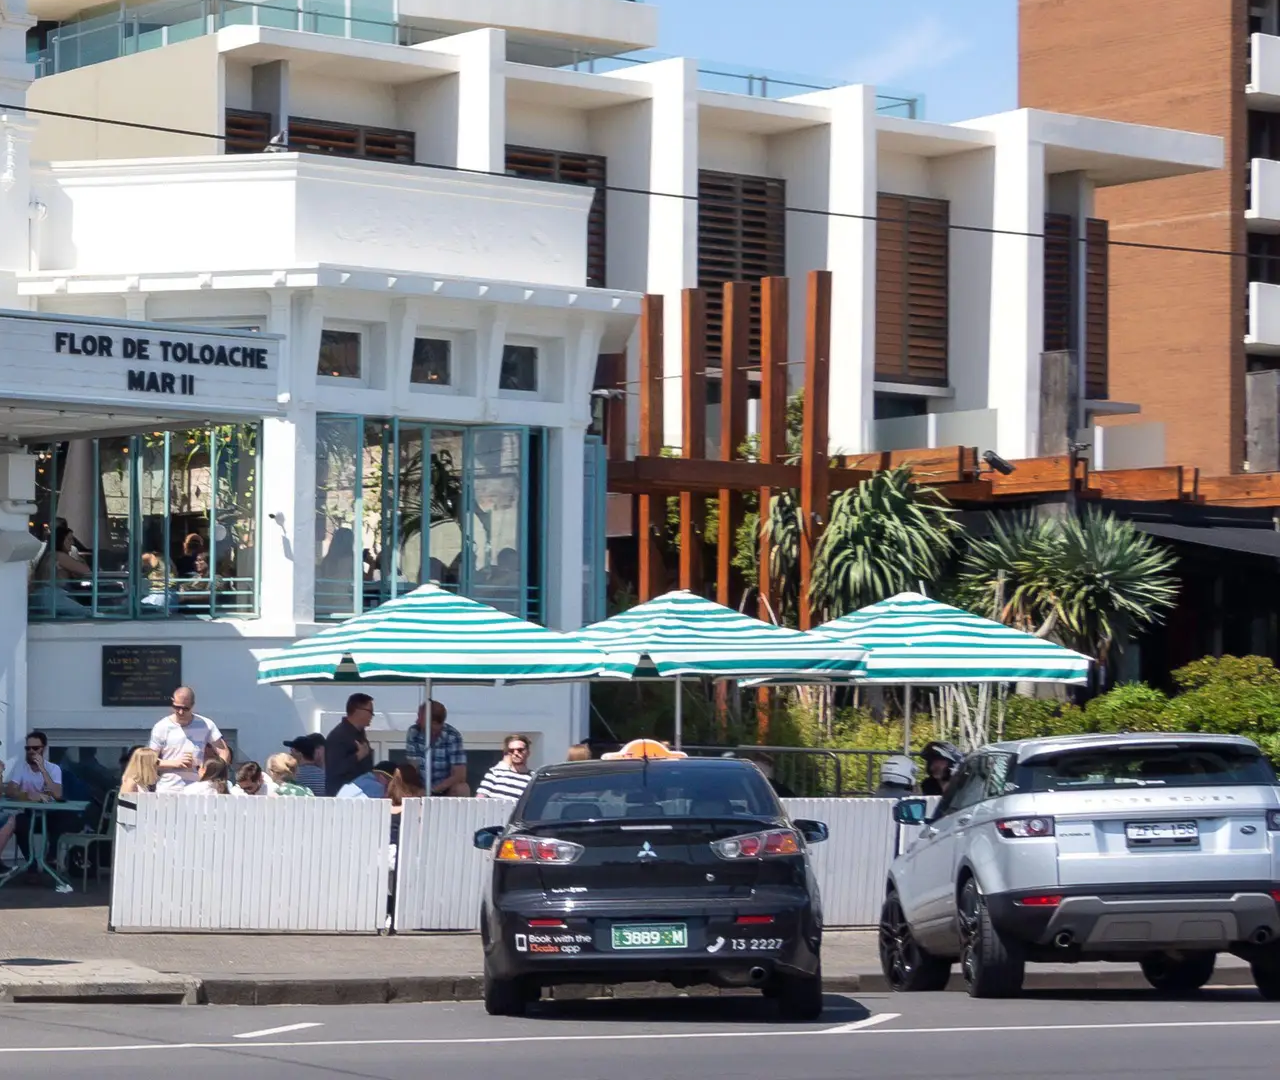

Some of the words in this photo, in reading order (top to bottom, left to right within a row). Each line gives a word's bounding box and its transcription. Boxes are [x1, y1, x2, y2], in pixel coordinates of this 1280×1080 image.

[55, 332, 113, 358] FLOR
[122, 336, 150, 360] DE
[161, 340, 268, 369] TOLOACHE
[127, 370, 175, 394] MAR
[528, 934, 552, 943] Book
[553, 935, 574, 943] with
[575, 934, 592, 943] the
[731, 938, 745, 950] 13
[751, 938, 783, 950] 2227
[560, 945, 581, 953] app
